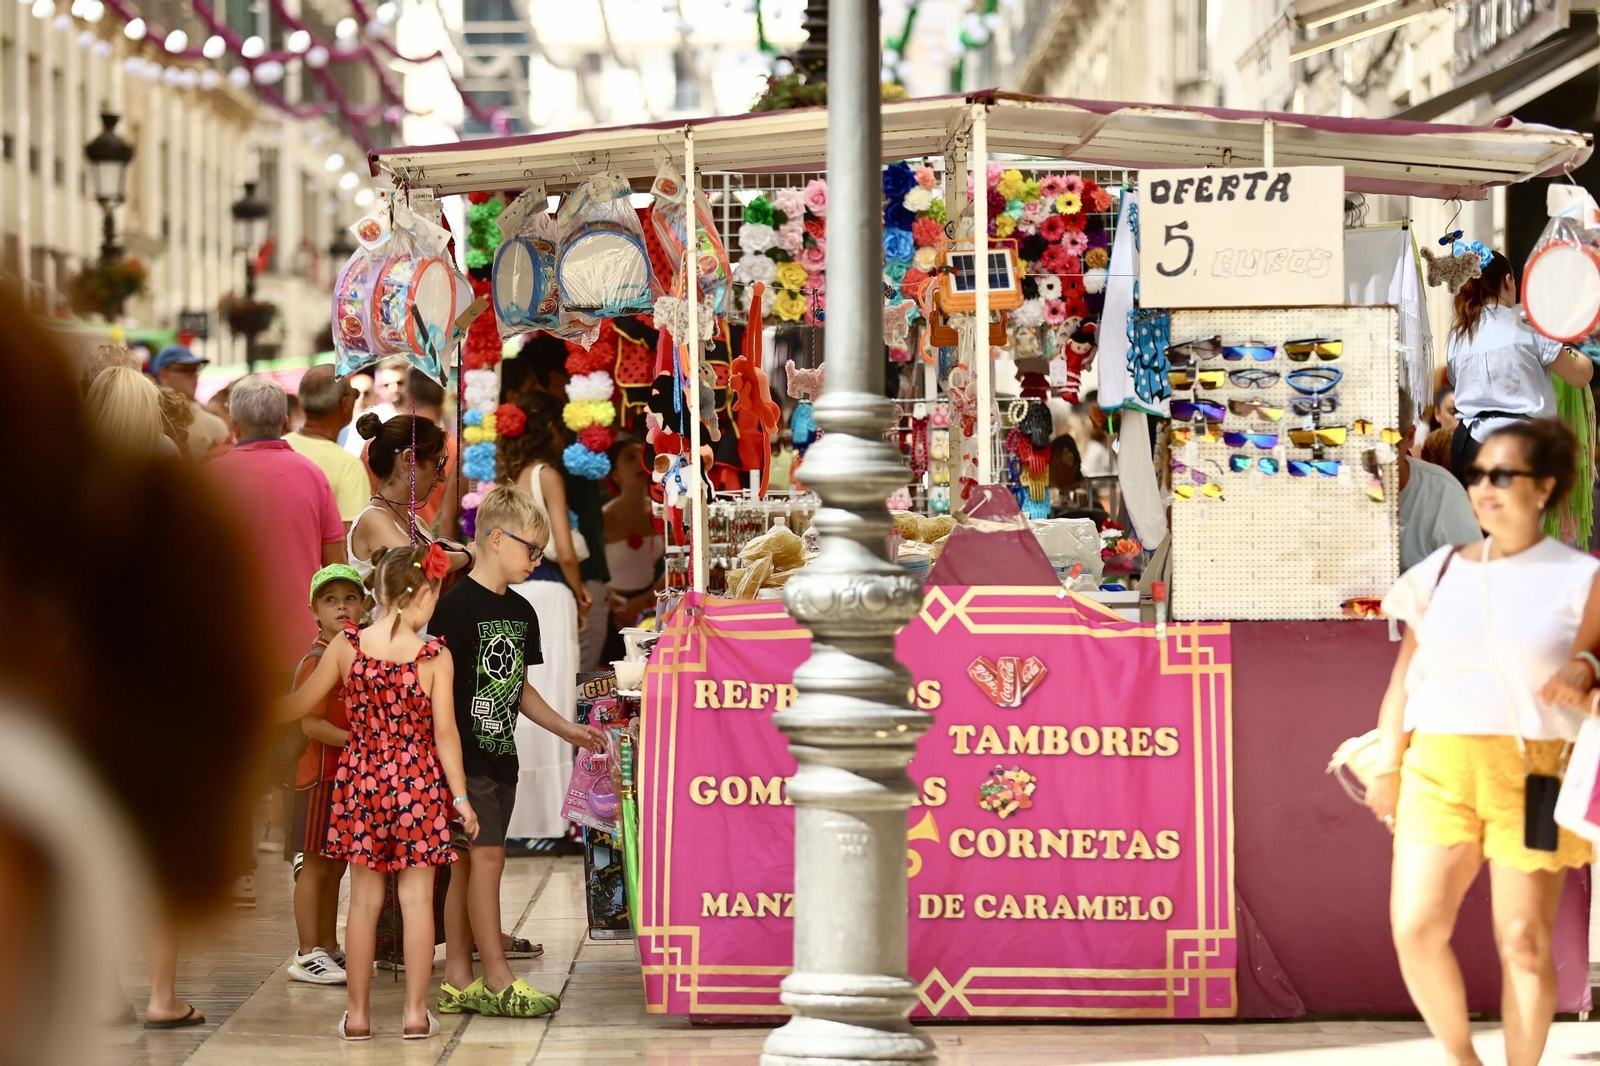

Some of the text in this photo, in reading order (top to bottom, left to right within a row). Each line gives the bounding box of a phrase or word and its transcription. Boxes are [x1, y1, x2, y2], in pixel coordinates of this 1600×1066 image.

[1150, 171, 1292, 205] OFERTA
[1211, 247, 1333, 279] EUROS
[477, 620, 528, 638] READY
[948, 724, 1180, 757] TAMBORES
[949, 828, 1181, 860] CORNETAS
[918, 894, 965, 919] DE
[973, 894, 1174, 921] CARAMELO
